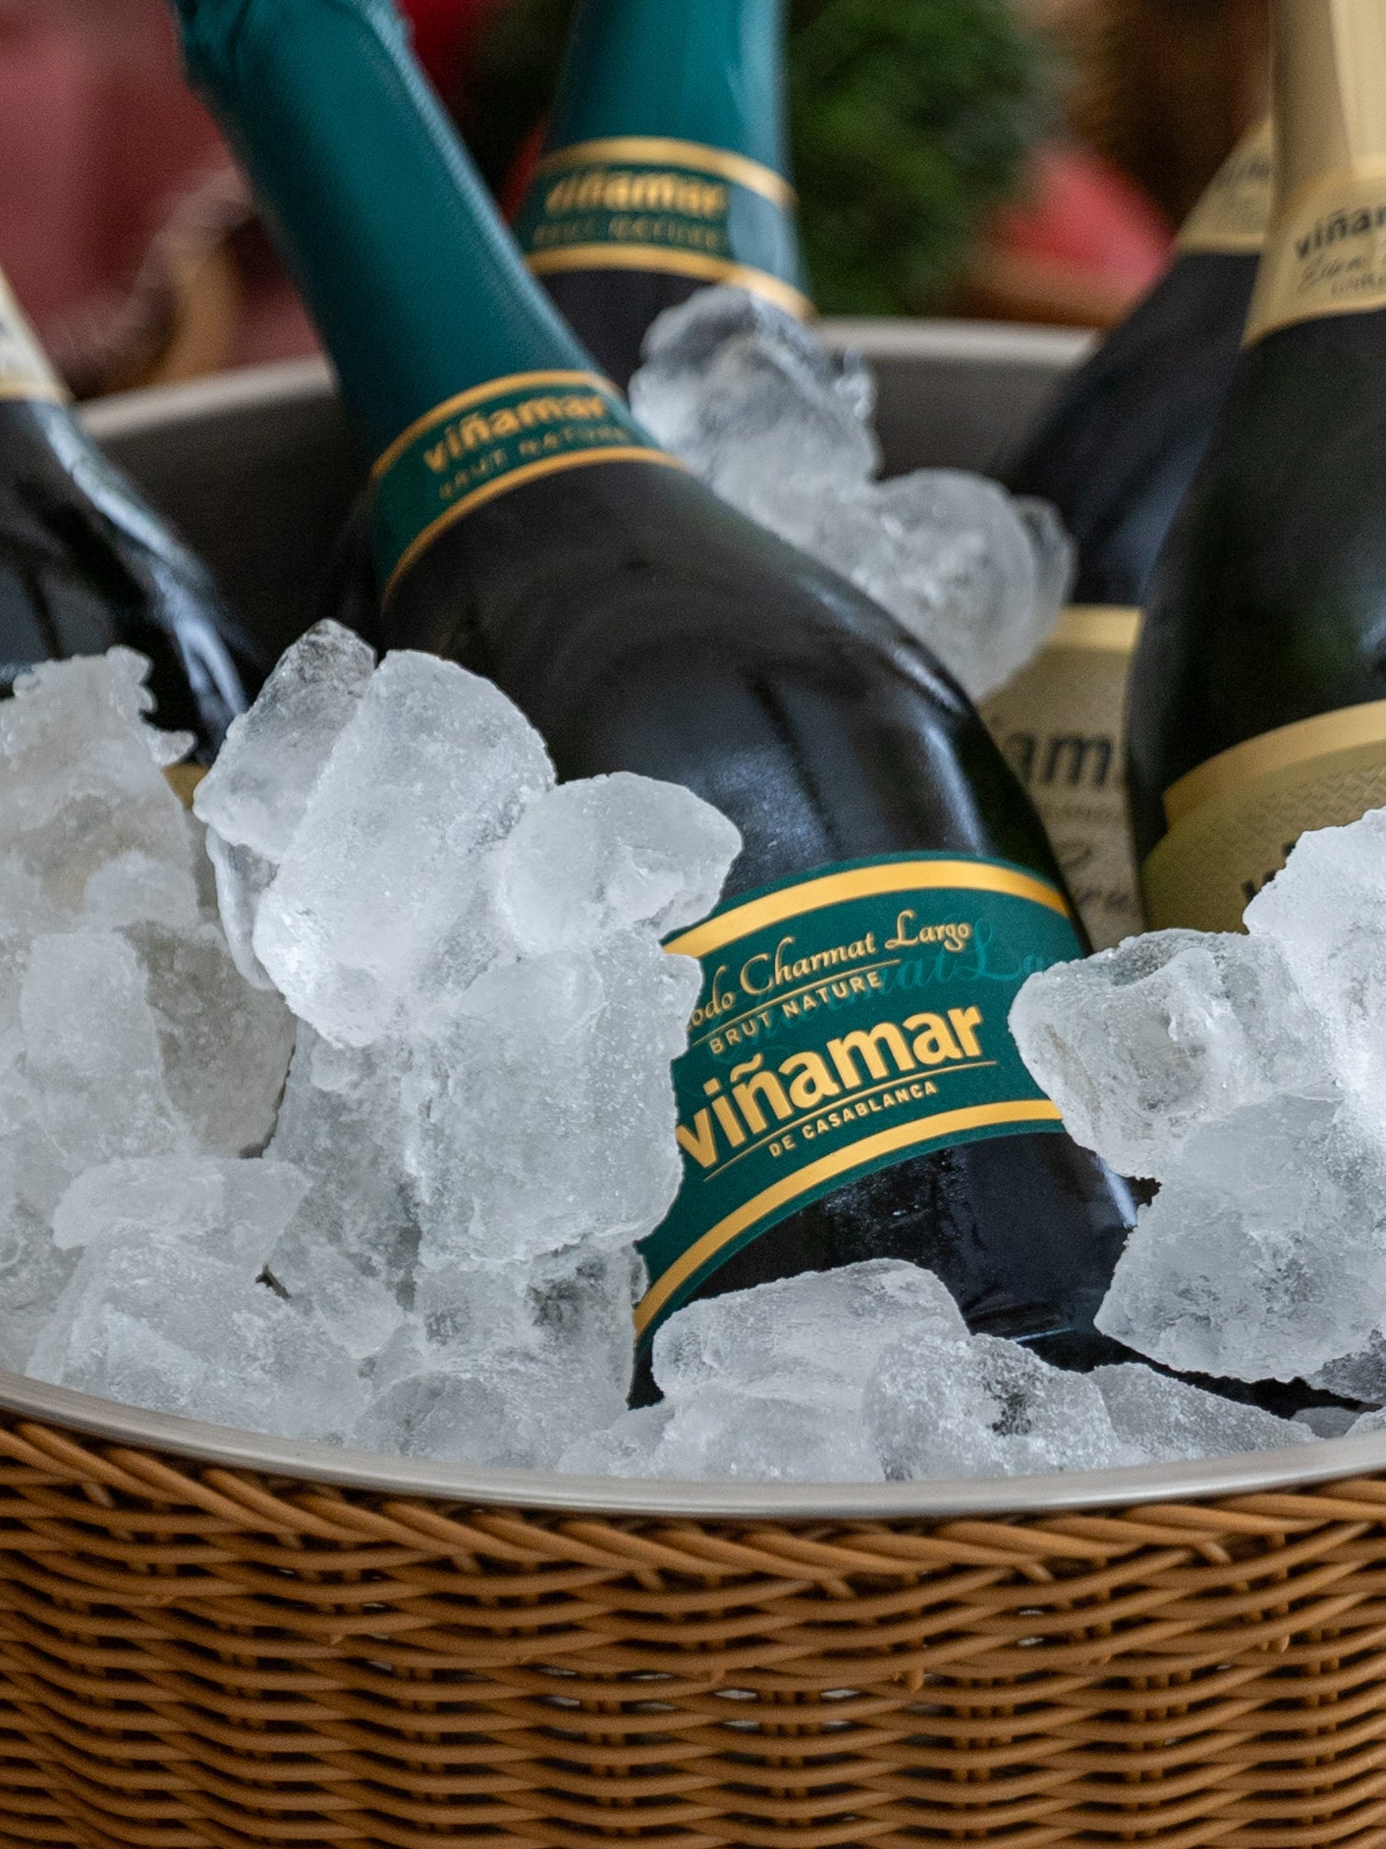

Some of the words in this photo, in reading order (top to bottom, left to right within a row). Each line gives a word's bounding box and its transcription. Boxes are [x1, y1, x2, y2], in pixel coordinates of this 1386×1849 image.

[422, 394, 608, 473] viñamar
[739, 936, 877, 996] Charmat
[884, 909, 972, 952] Largo
[708, 1011, 771, 1055] BRUT
[781, 970, 883, 1019] NATURE
[674, 1005, 984, 1169] viñamar
[768, 1133, 798, 1158] DE
[800, 1080, 939, 1140] CASABLANCA
